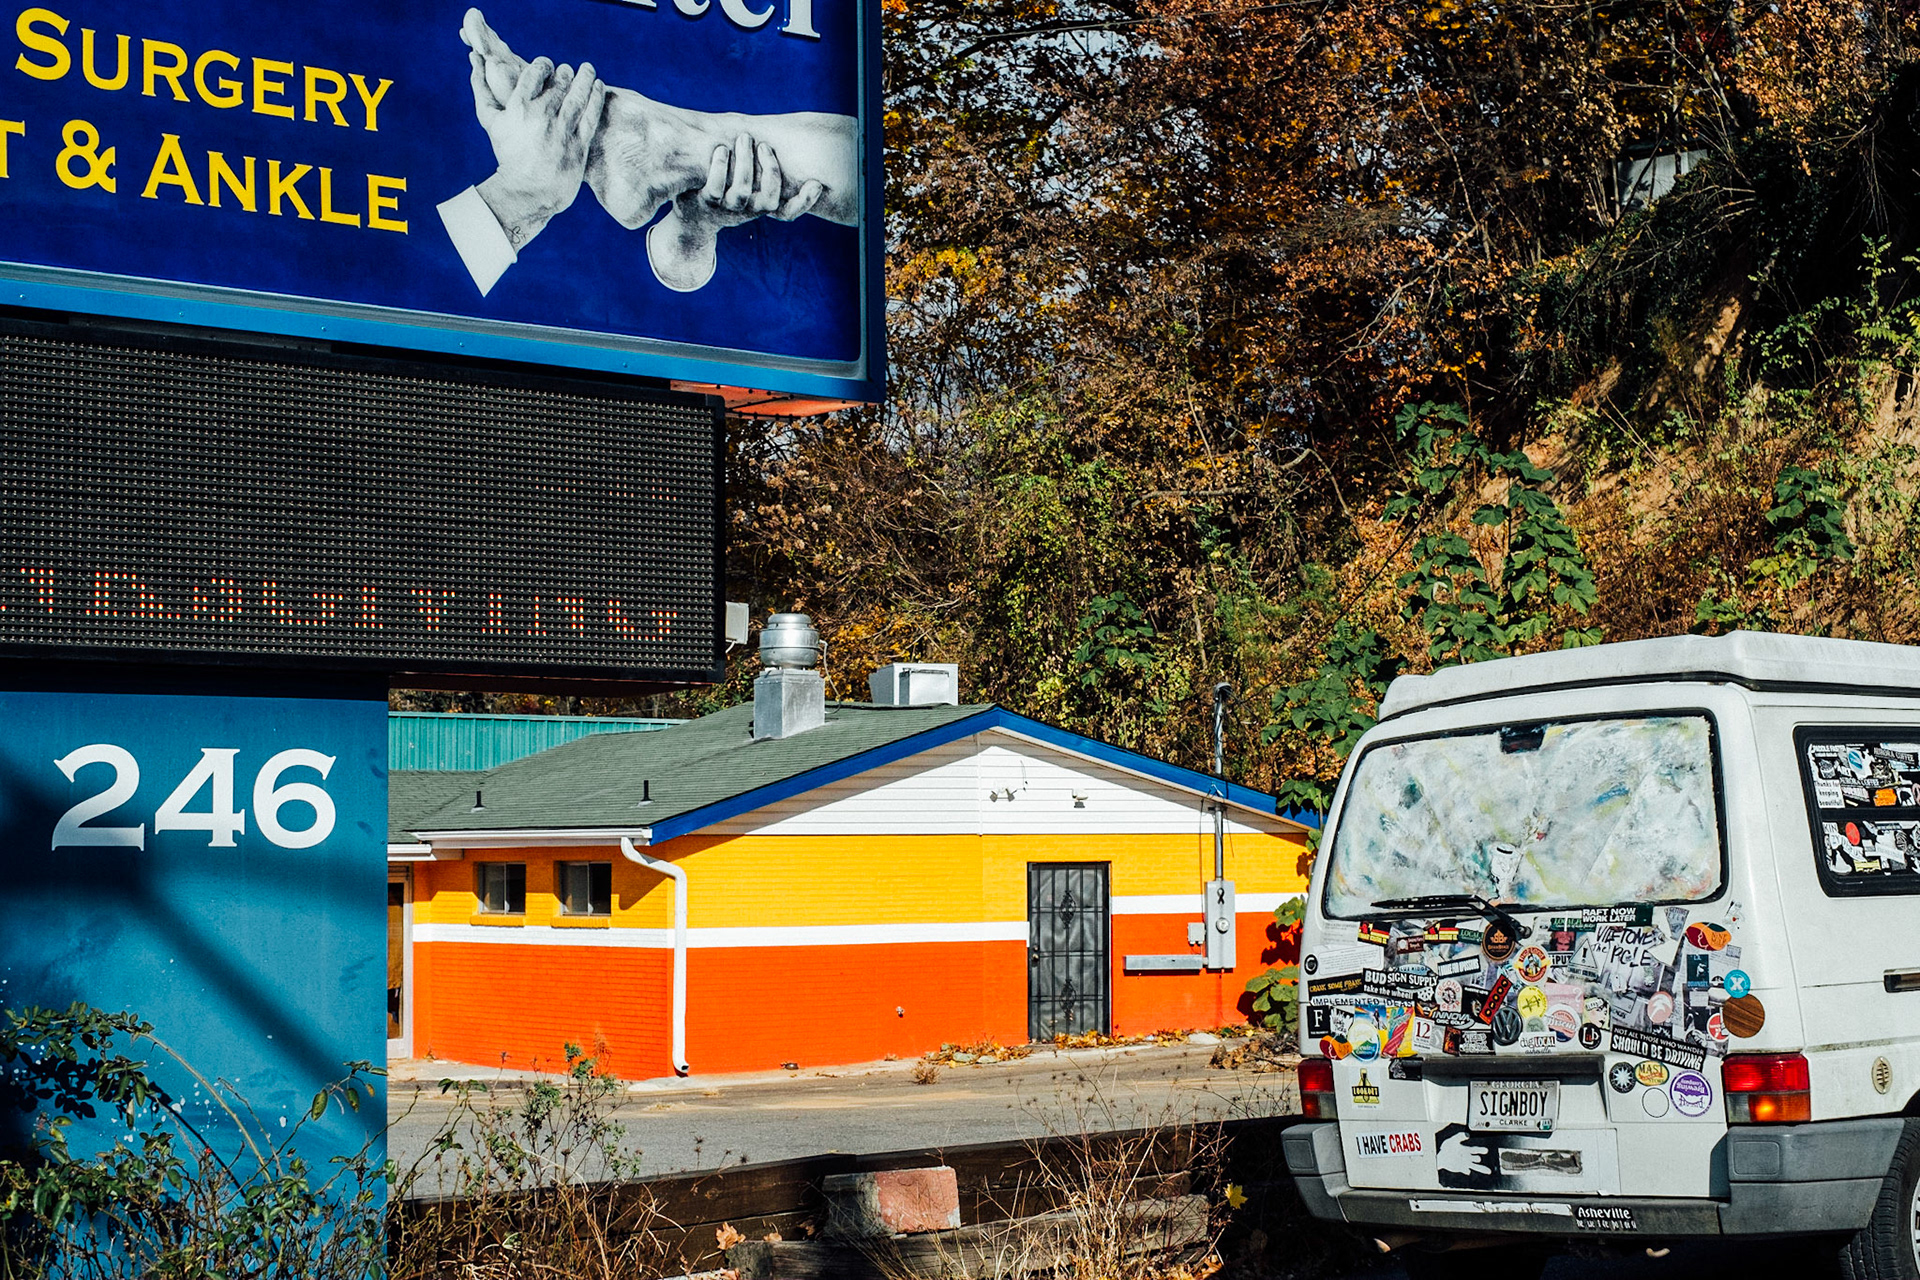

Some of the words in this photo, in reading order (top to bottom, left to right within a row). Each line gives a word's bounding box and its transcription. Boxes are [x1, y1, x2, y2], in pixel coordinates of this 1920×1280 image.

[15, 8, 394, 132] SURGERY
[55, 119, 116, 194] &
[141, 133, 408, 235] ANKLE
[52, 743, 337, 852] 246
[1583, 908, 1610, 916] RAFT
[1611, 907, 1636, 915] NOW
[1583, 915, 1609, 923] WORK
[1609, 914, 1636, 922] LATER
[1364, 970, 1387, 985] BUD
[1387, 972, 1407, 983] SIGN
[1408, 974, 1438, 987] SUPPLY
[1363, 984, 1378, 994] take
[1379, 985, 1391, 996] the
[1437, 980, 1460, 996] SECOND
[1312, 996, 1380, 1006] IMPLEMENTED
[1441, 1001, 1460, 1012] GEAR
[1313, 1009, 1324, 1028] F
[1432, 1011, 1470, 1022] INNOVA
[1415, 1021, 1431, 1040] 12
[1614, 1027, 1628, 1036] NOT
[1628, 1031, 1639, 1039] ALL
[1640, 1034, 1659, 1044] THOSE
[1659, 1039, 1677, 1048] WHO
[1677, 1043, 1705, 1056] WANDER
[1611, 1034, 1649, 1056] SHOULD
[1650, 1044, 1663, 1060] BE
[1664, 1047, 1703, 1071] DRIVING
[1491, 1081, 1540, 1089] GEORGIA
[1480, 1091, 1548, 1117] SIGNBOY
[1356, 1136, 1362, 1155] I
[1362, 1134, 1388, 1155] HAVE
[1389, 1132, 1421, 1153] CRABS
[1578, 1206, 1631, 1219] Asheville
